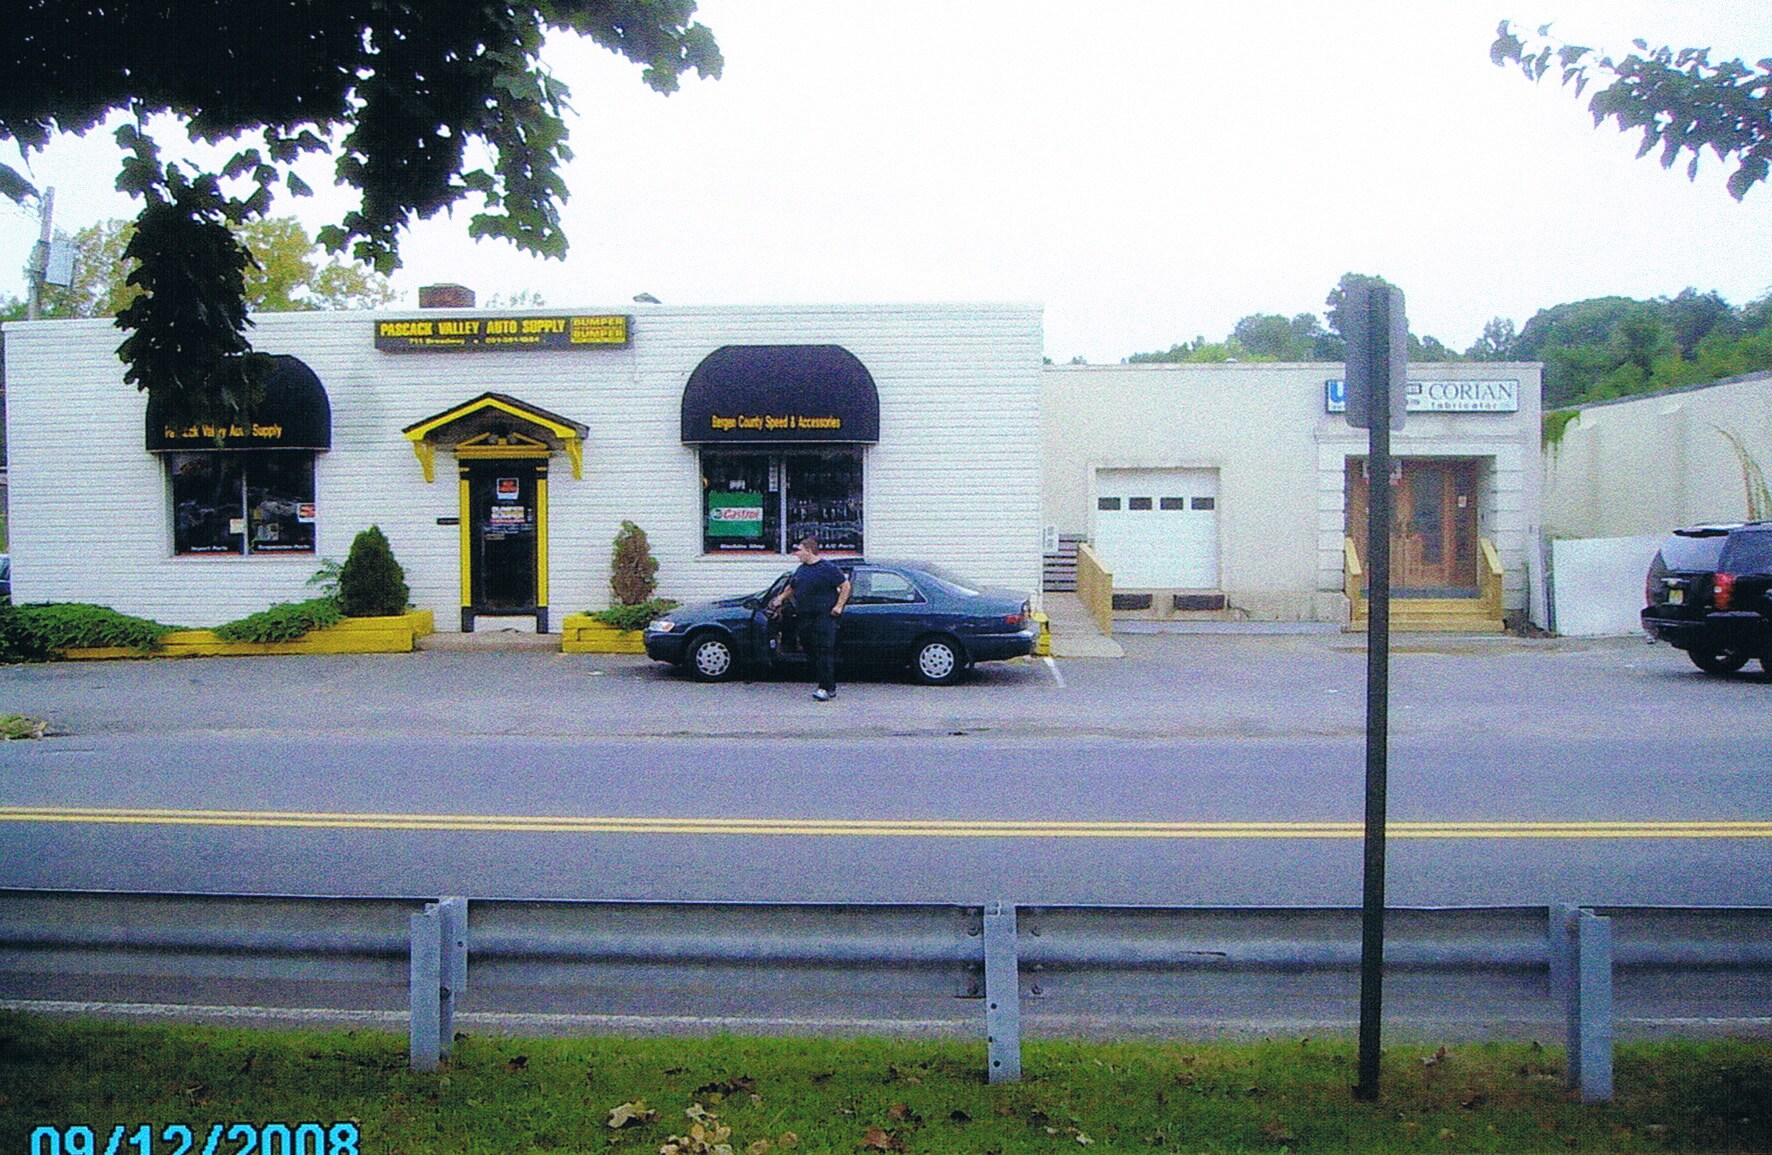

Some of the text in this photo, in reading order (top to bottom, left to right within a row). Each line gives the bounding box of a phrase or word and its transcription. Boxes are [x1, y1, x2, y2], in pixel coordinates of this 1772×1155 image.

[379, 318, 565, 336] PASCACK VALLEY AUTO SUPPLY
[573, 318, 624, 327] BUMPER
[573, 329, 624, 338] BUMPER
[1428, 383, 1512, 400] CORIAN
[1431, 401, 1498, 409] fabricator
[712, 415, 841, 431] Bergen County Speed & Accessories
[252, 423, 282, 439] Supply
[723, 509, 760, 520] Castrol
